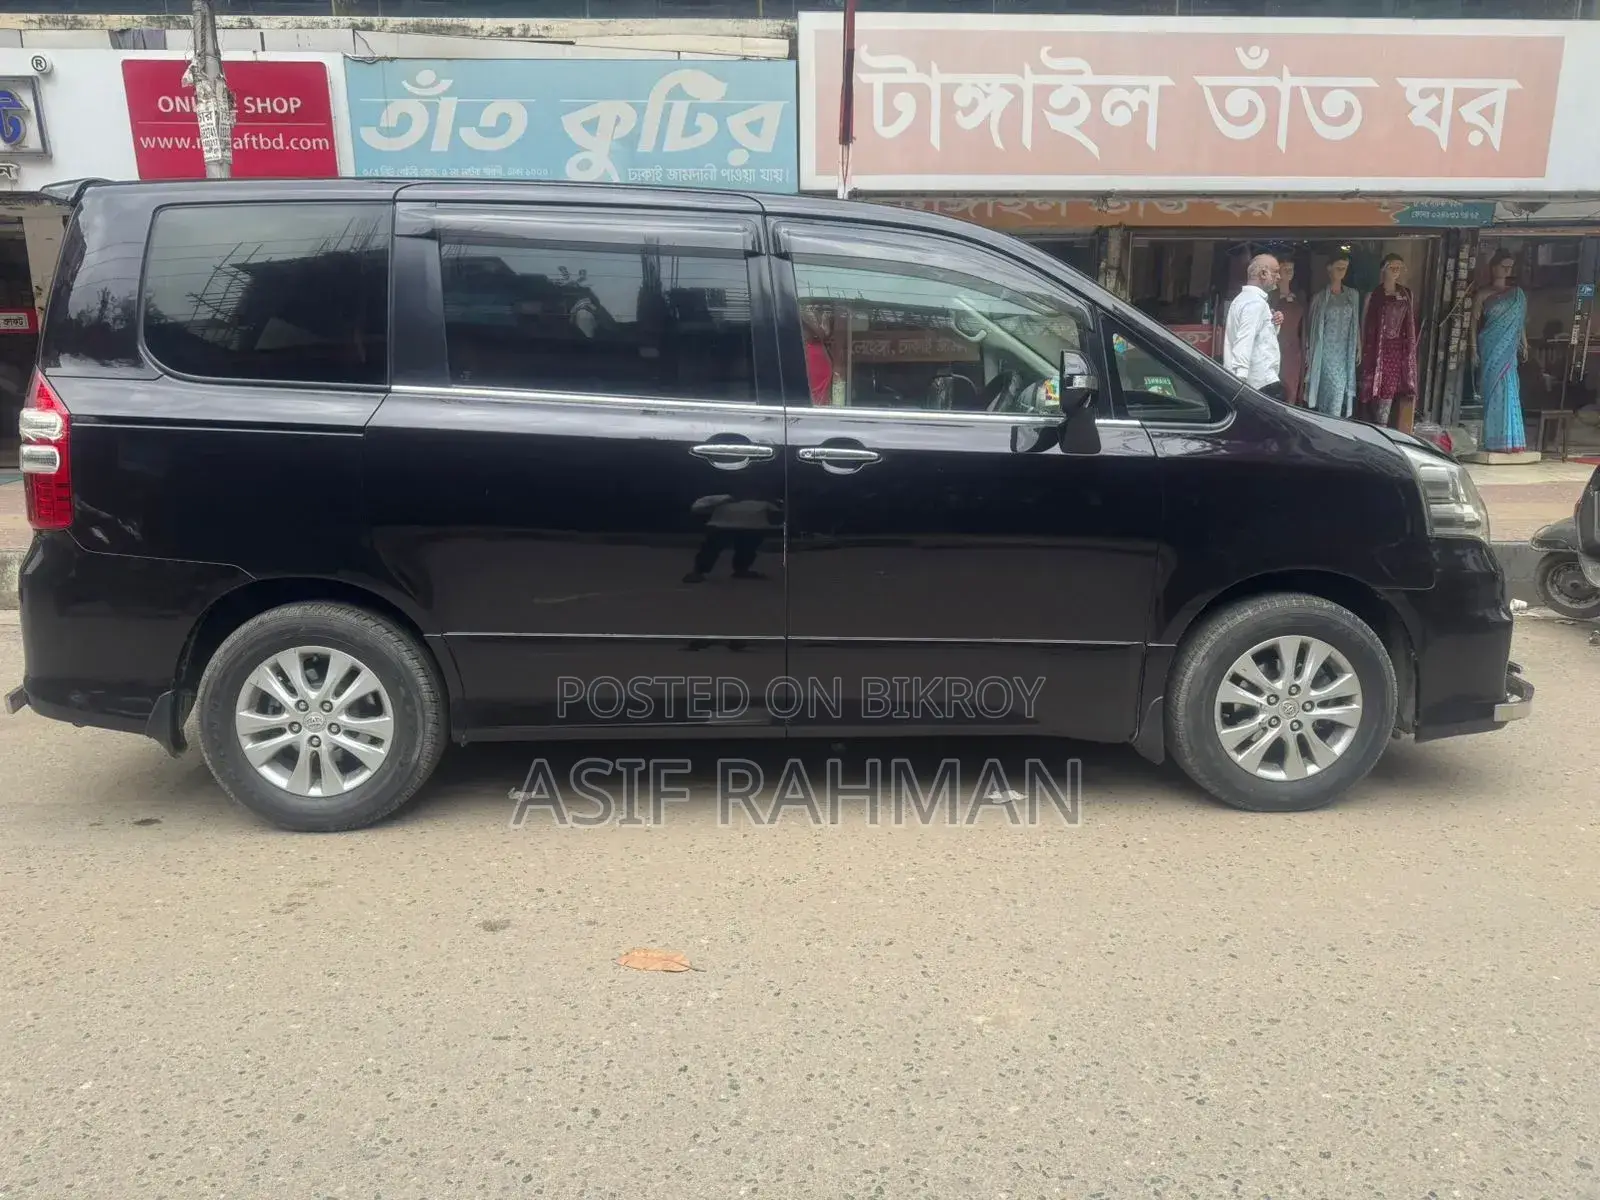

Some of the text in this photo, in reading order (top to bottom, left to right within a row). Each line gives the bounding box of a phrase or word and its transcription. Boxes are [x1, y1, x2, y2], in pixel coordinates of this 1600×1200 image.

[244, 97, 301, 114] SHOP
[360, 69, 789, 181] তাঁত কুটির
[857, 45, 1522, 160] টাঙ্গাইল তাঁত ঘর
[627, 165, 662, 182] ঢাকাই
[667, 163, 717, 182] জামদানী
